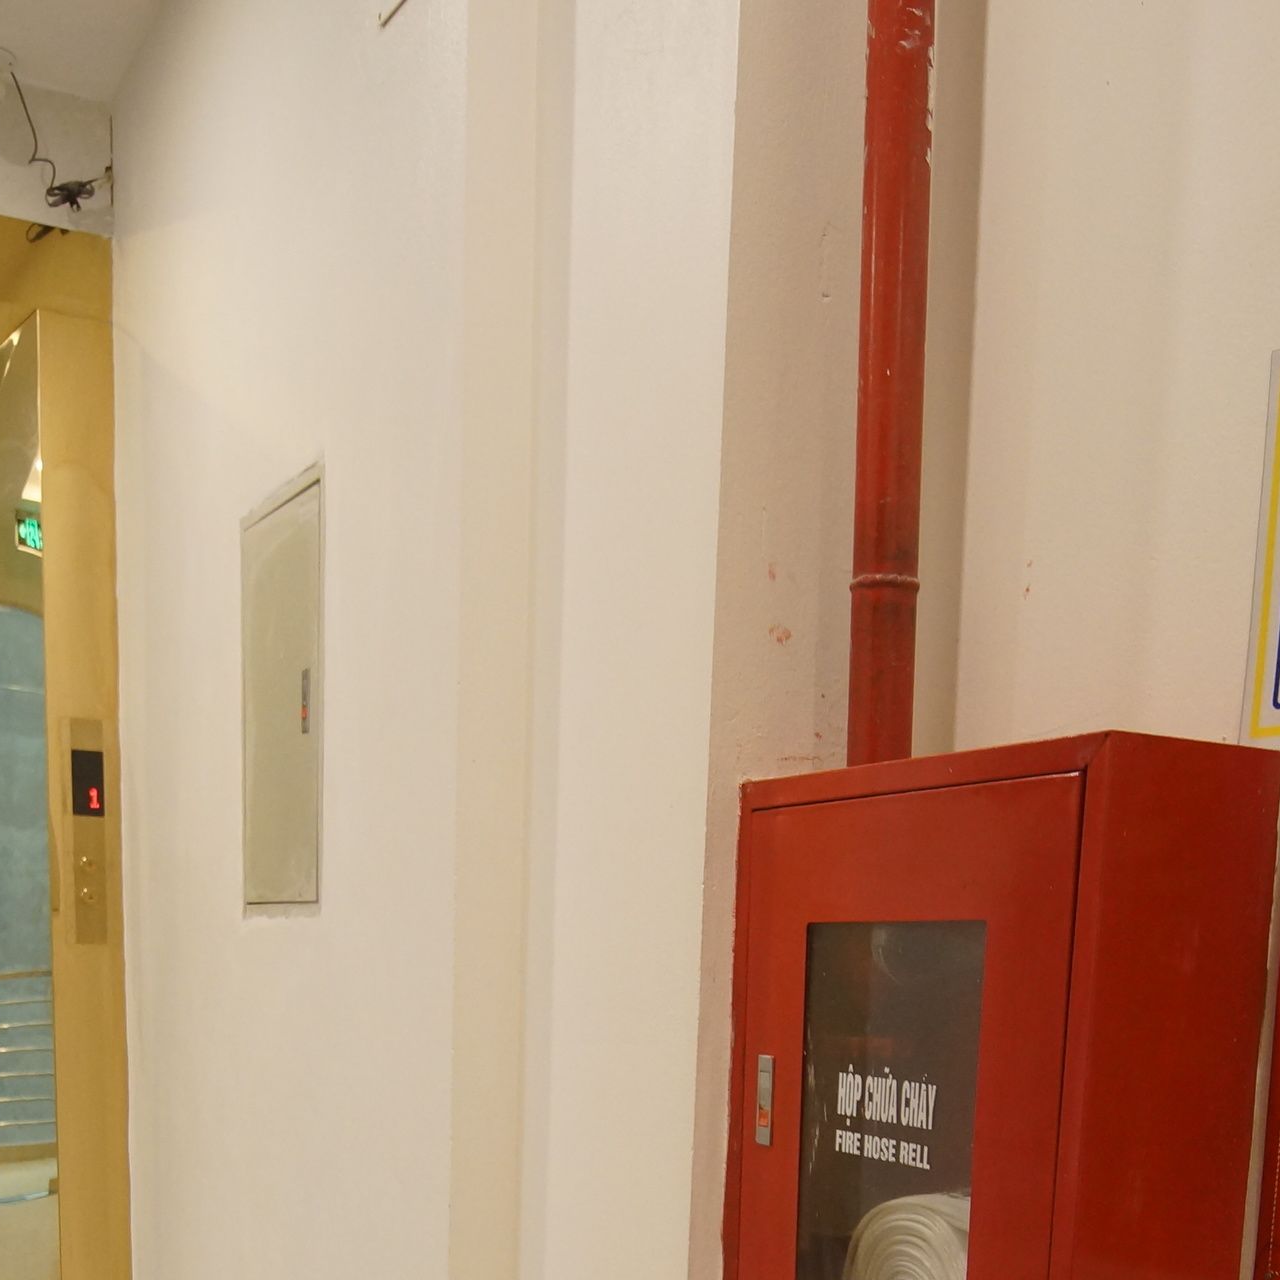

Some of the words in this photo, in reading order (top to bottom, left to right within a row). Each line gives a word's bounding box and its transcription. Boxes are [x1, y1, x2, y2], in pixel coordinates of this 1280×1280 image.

[88, 786, 101, 809] 1
[837, 1063, 863, 1127] HỘP
[864, 1066, 898, 1125] CHỮA
[900, 1073, 937, 1130] CHÁY
[835, 1129, 862, 1156] FIRE
[863, 1134, 897, 1162] HOSE
[899, 1140, 931, 1170] RELL
